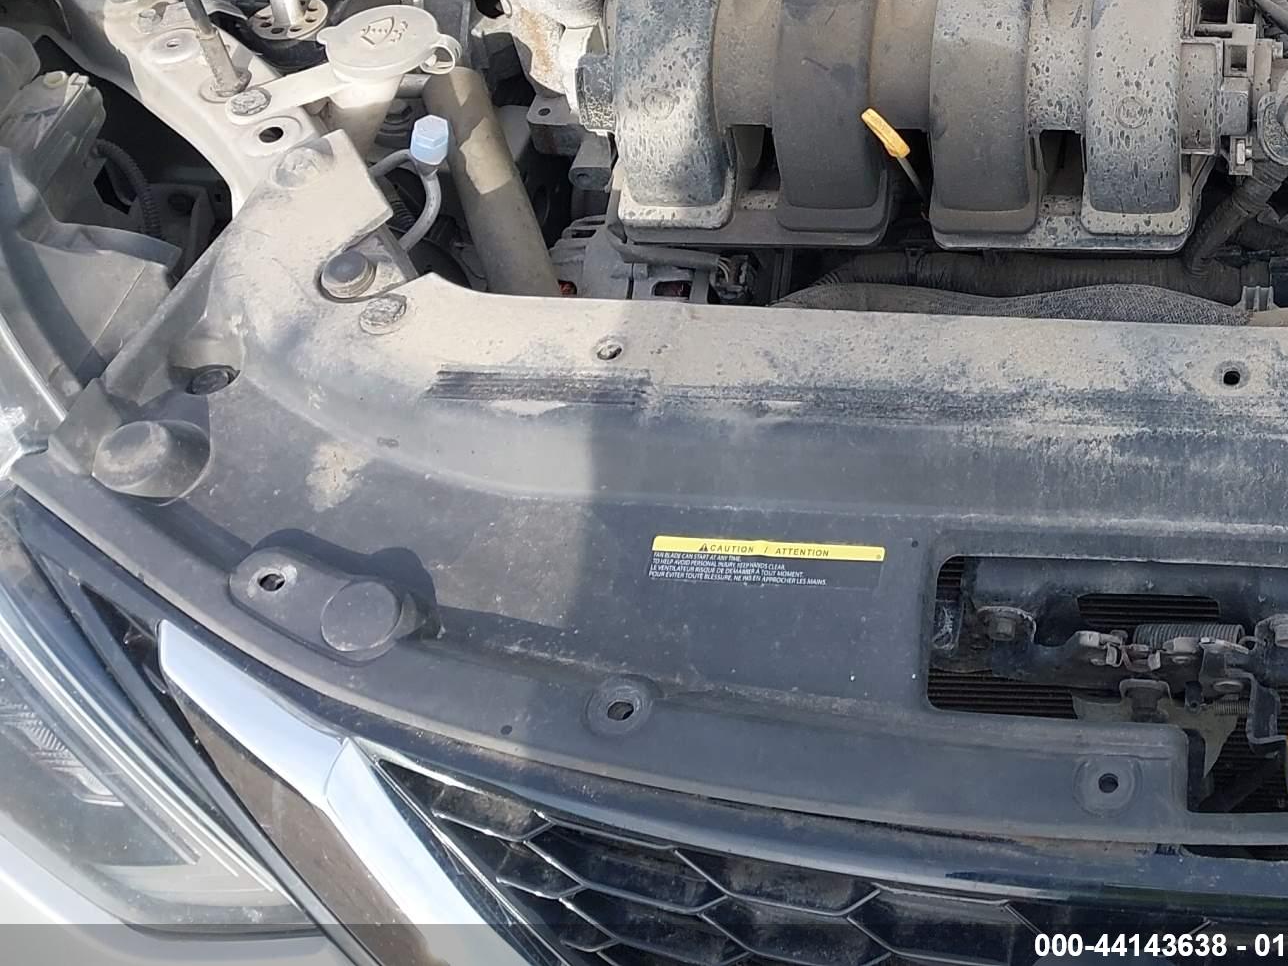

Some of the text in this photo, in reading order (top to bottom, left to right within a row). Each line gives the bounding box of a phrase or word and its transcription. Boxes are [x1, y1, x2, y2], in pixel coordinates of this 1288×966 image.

[709, 544, 754, 554] CAUTION
[775, 547, 830, 557] ATTENTION
[695, 566, 715, 574] RISQUE
